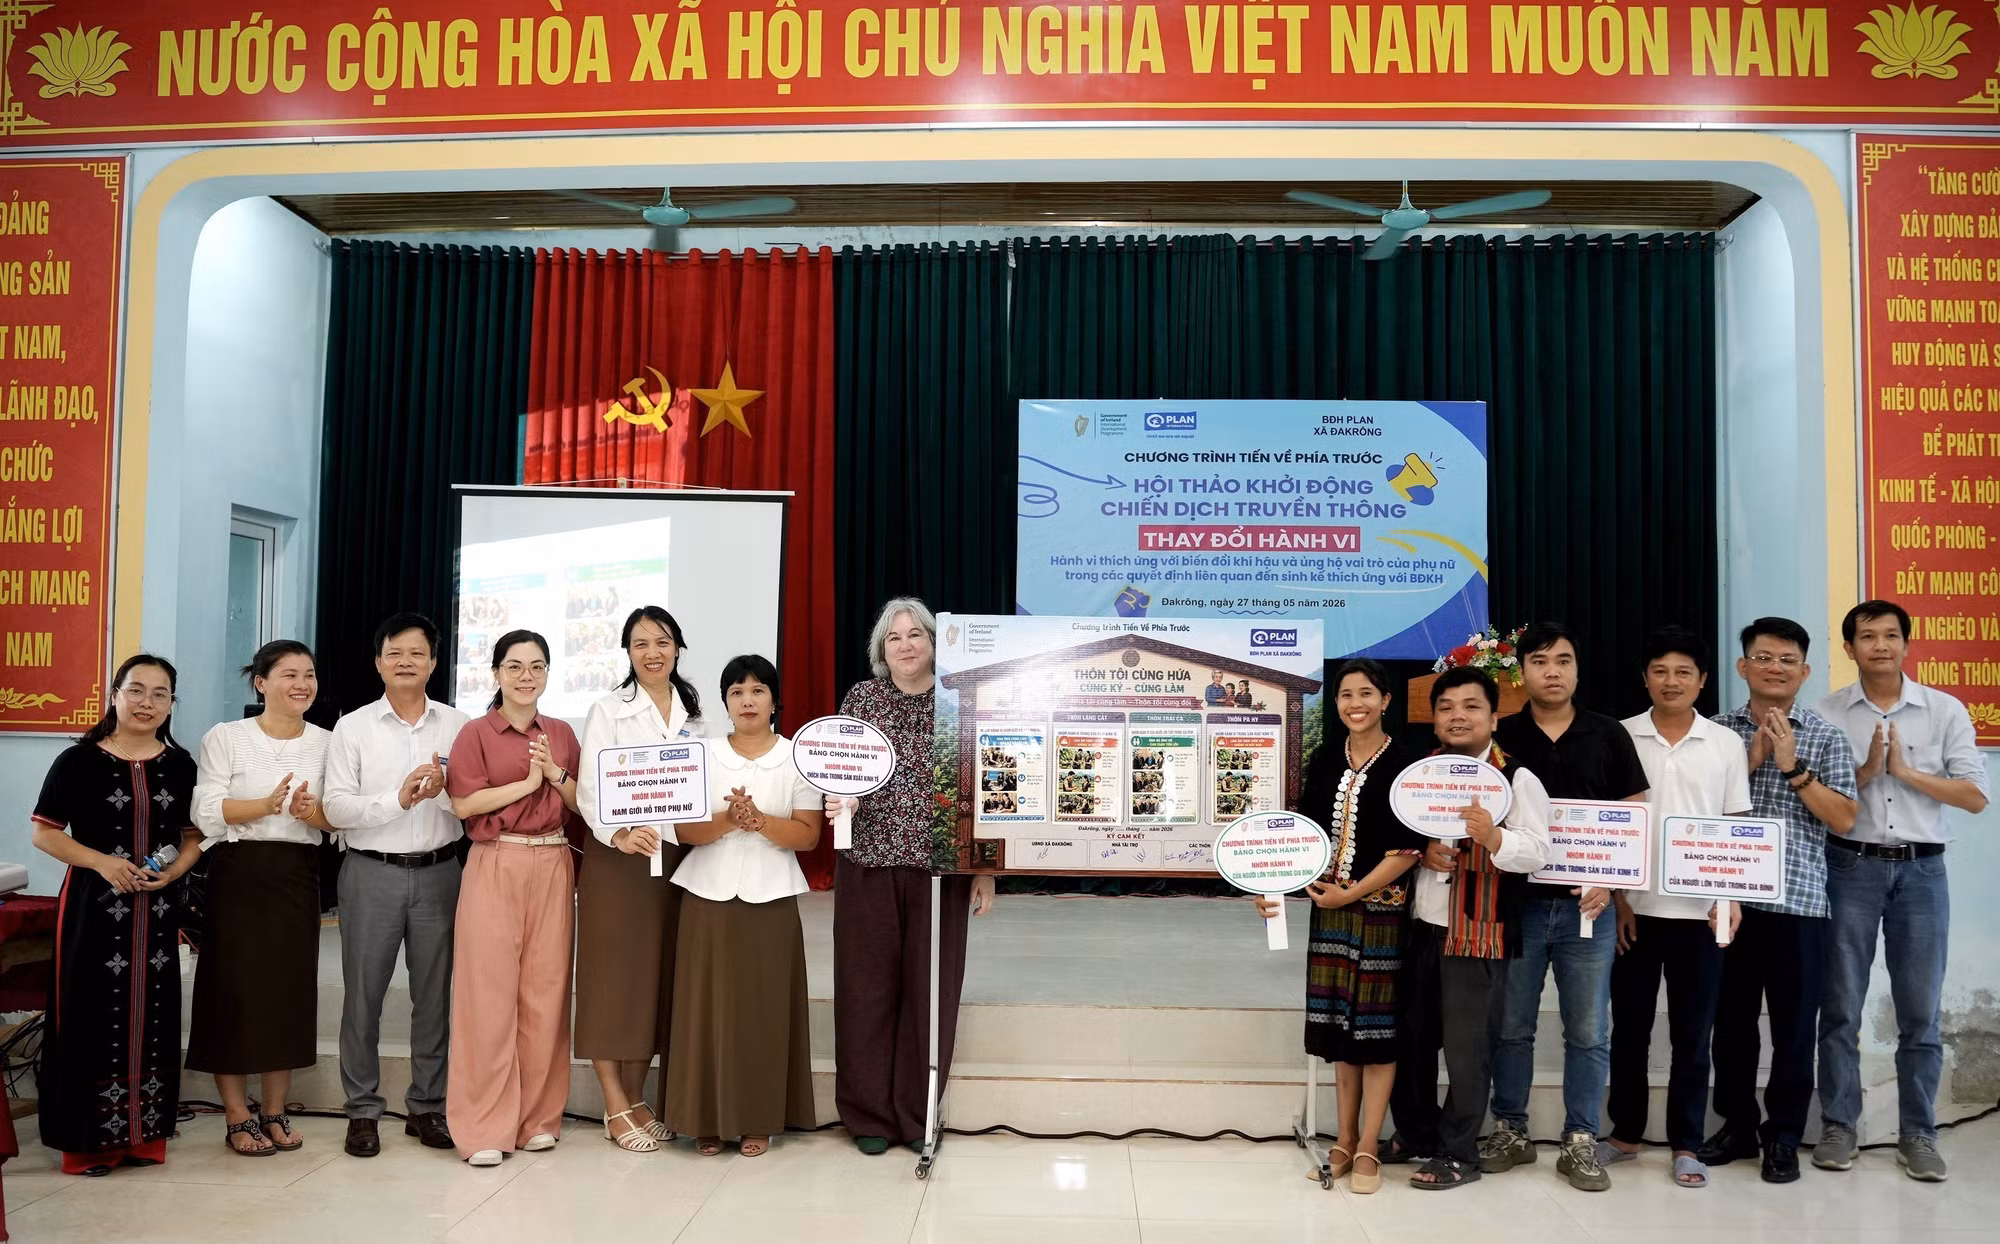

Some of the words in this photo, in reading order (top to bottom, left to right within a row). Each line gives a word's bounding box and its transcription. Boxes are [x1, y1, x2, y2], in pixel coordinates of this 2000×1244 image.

[158, 12, 306, 96] NƯỚC
[327, 8, 478, 106] CỘNG
[499, 0, 611, 85] HÒA
[630, 0, 707, 81] XÃ
[728, 0, 822, 94] HỘI
[1185, 0, 1310, 90] VIỆT
[1331, 5, 1468, 73] NAM
[1490, 0, 1669, 76] MUÔN
[1901, 210, 1928, 237] XÂY
[1934, 213, 1973, 242] DỰNG
[29, 250, 70, 295] SẢN
[1887, 253, 1906, 280] VÀ
[1911, 253, 1929, 285] HỆ
[1934, 250, 1981, 281] THỐNG
[1887, 295, 1926, 322] VỮNG
[1931, 300, 1974, 327] MẠNH
[15, 325, 65, 363] NAM,
[1892, 343, 1920, 365] HUY
[1925, 338, 1965, 371] ĐỘNG
[1970, 339, 1988, 366] VÀ
[54, 386, 98, 427] ĐẠO,
[1882, 383, 1914, 415] HIỆU
[1920, 380, 1949, 413] QUẢ
[1954, 384, 1982, 411] CÁC
[1166, 416, 1194, 424] PLAN
[1314, 426, 1327, 435] XÃ
[1331, 427, 1381, 436] ĐAKRÔNG
[1347, 416, 1373, 424] PLAN
[1924, 423, 1942, 455] ĐỂ
[1947, 429, 1984, 456] PHÁT
[1, 440, 53, 481] CHỨC
[1125, 452, 1189, 462] CHƯƠNG
[1193, 450, 1235, 462] TRÌNH
[1239, 450, 1269, 462] TIẾN
[1274, 450, 1291, 462] VỀ
[1296, 451, 1329, 463] PHÍA
[1333, 452, 1382, 463] TRƯỚC
[1134, 475, 1173, 498] HỘI
[1179, 474, 1240, 494] THẢO
[1246, 474, 1300, 494] KHỞI
[1306, 476, 1373, 499] ĐỘNG
[1880, 479, 1914, 502] KINH
[1919, 472, 1936, 502] TẾ
[1952, 476, 1970, 503] XÃ
[1976, 476, 1999, 508] HỘI
[1101, 495, 1168, 516] CHIẾN
[1175, 502, 1228, 521] DỊCH
[1235, 496, 1320, 517] TRUYỀN
[1327, 500, 1406, 518] THÔNG
[52, 505, 82, 551] LỢI
[1144, 533, 1205, 547] THAY
[1210, 526, 1251, 547] ĐỔI
[1259, 529, 1326, 548] HÀNH
[1333, 534, 1355, 548] VI
[1892, 517, 1930, 550] QUỐC
[1936, 520, 1985, 549] PHÒNG
[1051, 555, 1082, 565] Hành
[1086, 555, 1096, 565] vi
[1100, 555, 1130, 565] thích
[1135, 555, 1158, 569] ứng
[1161, 556, 1178, 565] với
[1182, 555, 1208, 566] biến
[1212, 555, 1230, 566] đổi
[1234, 556, 1252, 566] khí
[1256, 557, 1279, 569] hậu
[1283, 556, 1297, 566] và
[1301, 556, 1325, 571] ủng
[1328, 557, 1342, 570] hộ
[1345, 557, 1363, 567] vai
[1367, 558, 1384, 567] trò
[1387, 557, 1409, 568] của
[1413, 559, 1436, 571] phụ
[1440, 560, 1455, 569] nữ
[1066, 571, 1098, 583] trong
[1102, 571, 1123, 580] các
[1127, 571, 1161, 583] quyết
[1165, 571, 1192, 583] định
[1196, 571, 1217, 580] liên
[1221, 573, 1252, 583] quan
[1256, 571, 1278, 581] đến
[1282, 571, 1307, 581] sinh
[1311, 571, 1324, 581] kế
[1327, 572, 1358, 582] thích
[1362, 572, 1385, 585] ứng
[1389, 573, 1406, 582] với
[1410, 574, 1442, 583] BĐKH
[31, 571, 89, 612] MẠNG
[1896, 562, 1924, 594] ĐẨY
[1930, 572, 1973, 600] MẠNH
[1162, 597, 1207, 608] Đakrông,
[1211, 599, 1234, 608] ngày
[1252, 599, 1280, 608] tháng
[1323, 599, 1345, 607] 2026
[1926, 612, 1975, 640] NGHÈO
[1981, 613, 1999, 640] VÀ
[7, 632, 52, 666] NAM
[1076, 668, 1105, 679] THÔN
[1110, 668, 1127, 680] TÔI
[1132, 668, 1163, 680] CÙNG
[1168, 668, 1191, 680] HỨA
[1080, 684, 1107, 692] CÙNG
[1110, 684, 1122, 692] KÝ
[1135, 683, 1161, 692] CÙNG
[1165, 683, 1184, 693] LÀM
[1915, 657, 1958, 687] NÔNG
